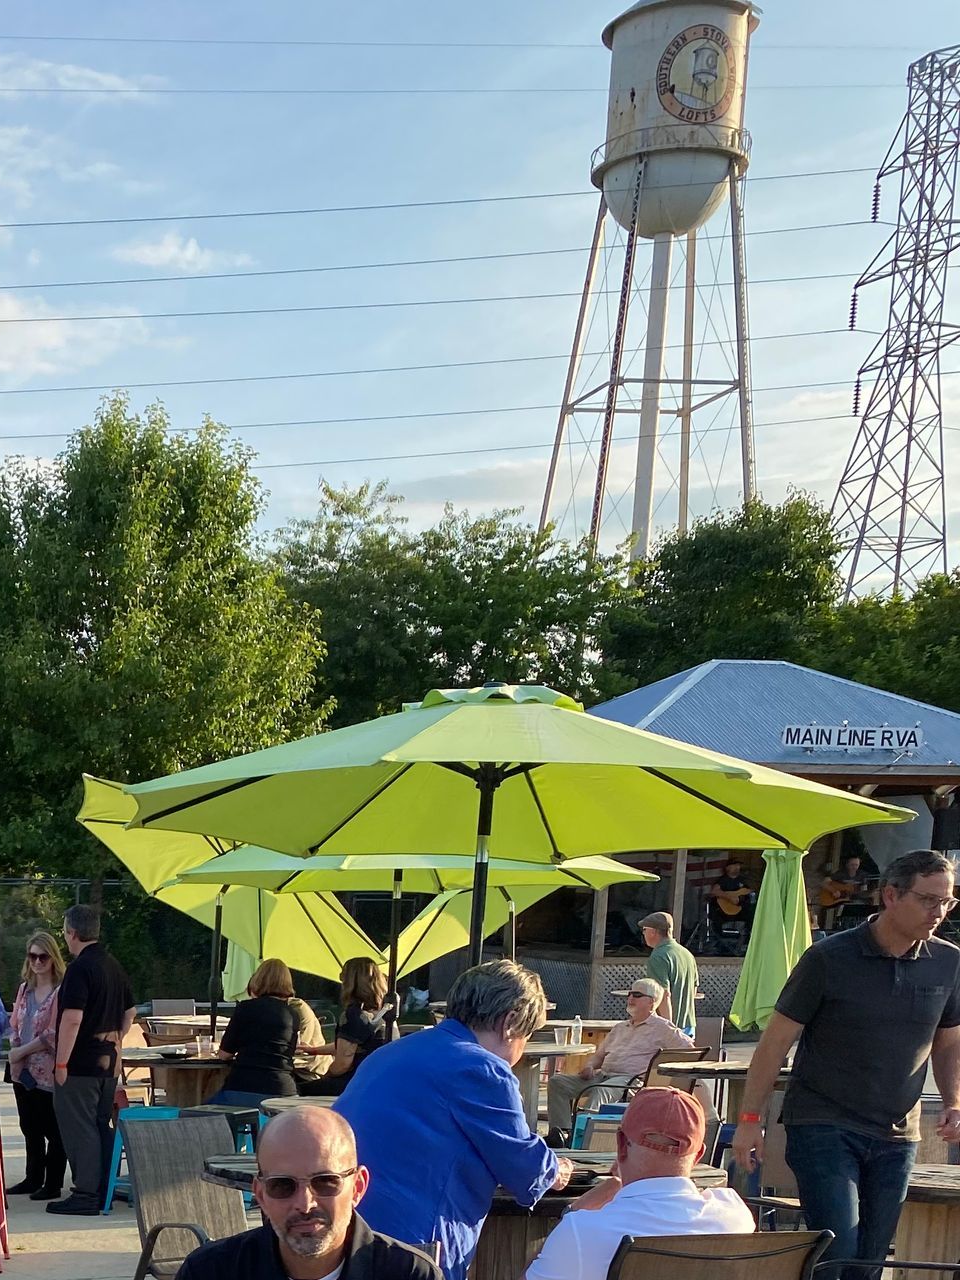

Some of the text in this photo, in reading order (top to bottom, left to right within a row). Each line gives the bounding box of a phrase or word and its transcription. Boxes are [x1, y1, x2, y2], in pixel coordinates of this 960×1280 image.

[659, 33, 688, 96] SOUTHERN
[678, 108, 717, 122] LOFTS
[785, 727, 919, 748] MAIN LINE RVA
